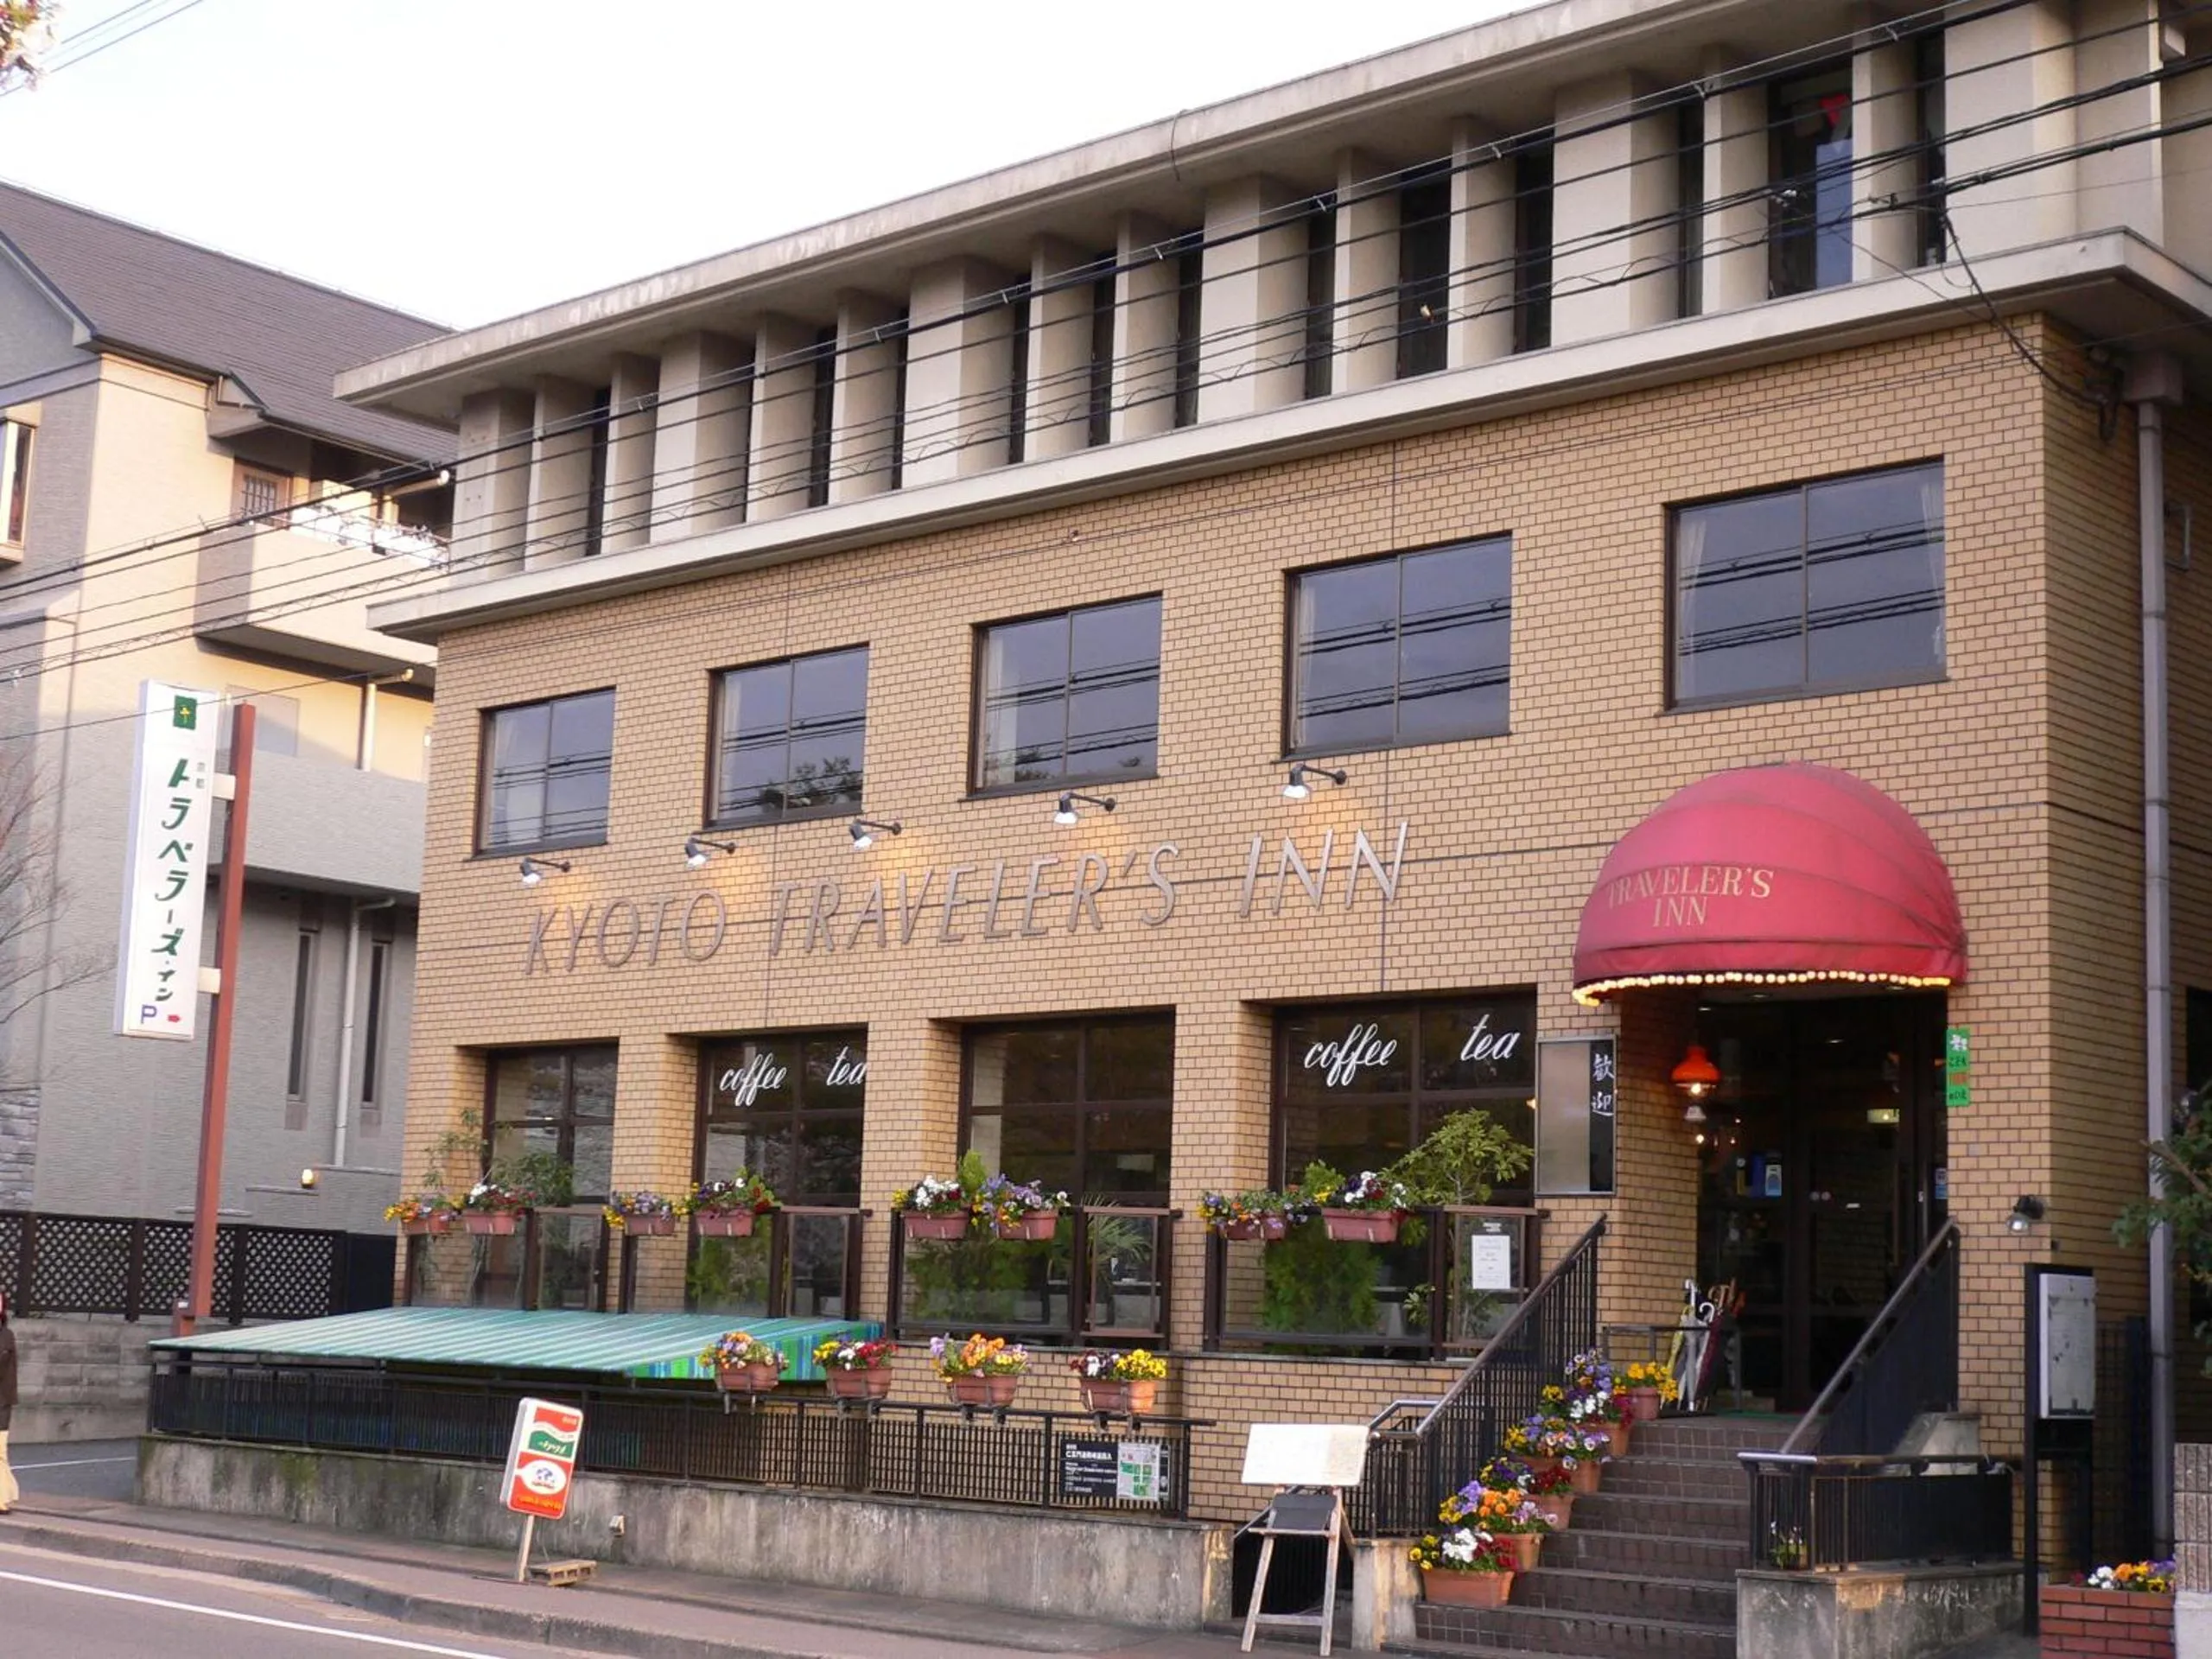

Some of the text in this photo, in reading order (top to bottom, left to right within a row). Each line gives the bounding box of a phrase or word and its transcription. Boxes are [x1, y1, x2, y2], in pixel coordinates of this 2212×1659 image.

[524, 821, 1408, 975] KYOTO TRAVELER'S INN
[1606, 866, 1774, 908] TRAVELER'S
[1652, 896, 1708, 927] INN
[140, 1004, 158, 1024] P
[719, 1045, 868, 1106] coffee tea
[1304, 1014, 1521, 1087] coffee tea
